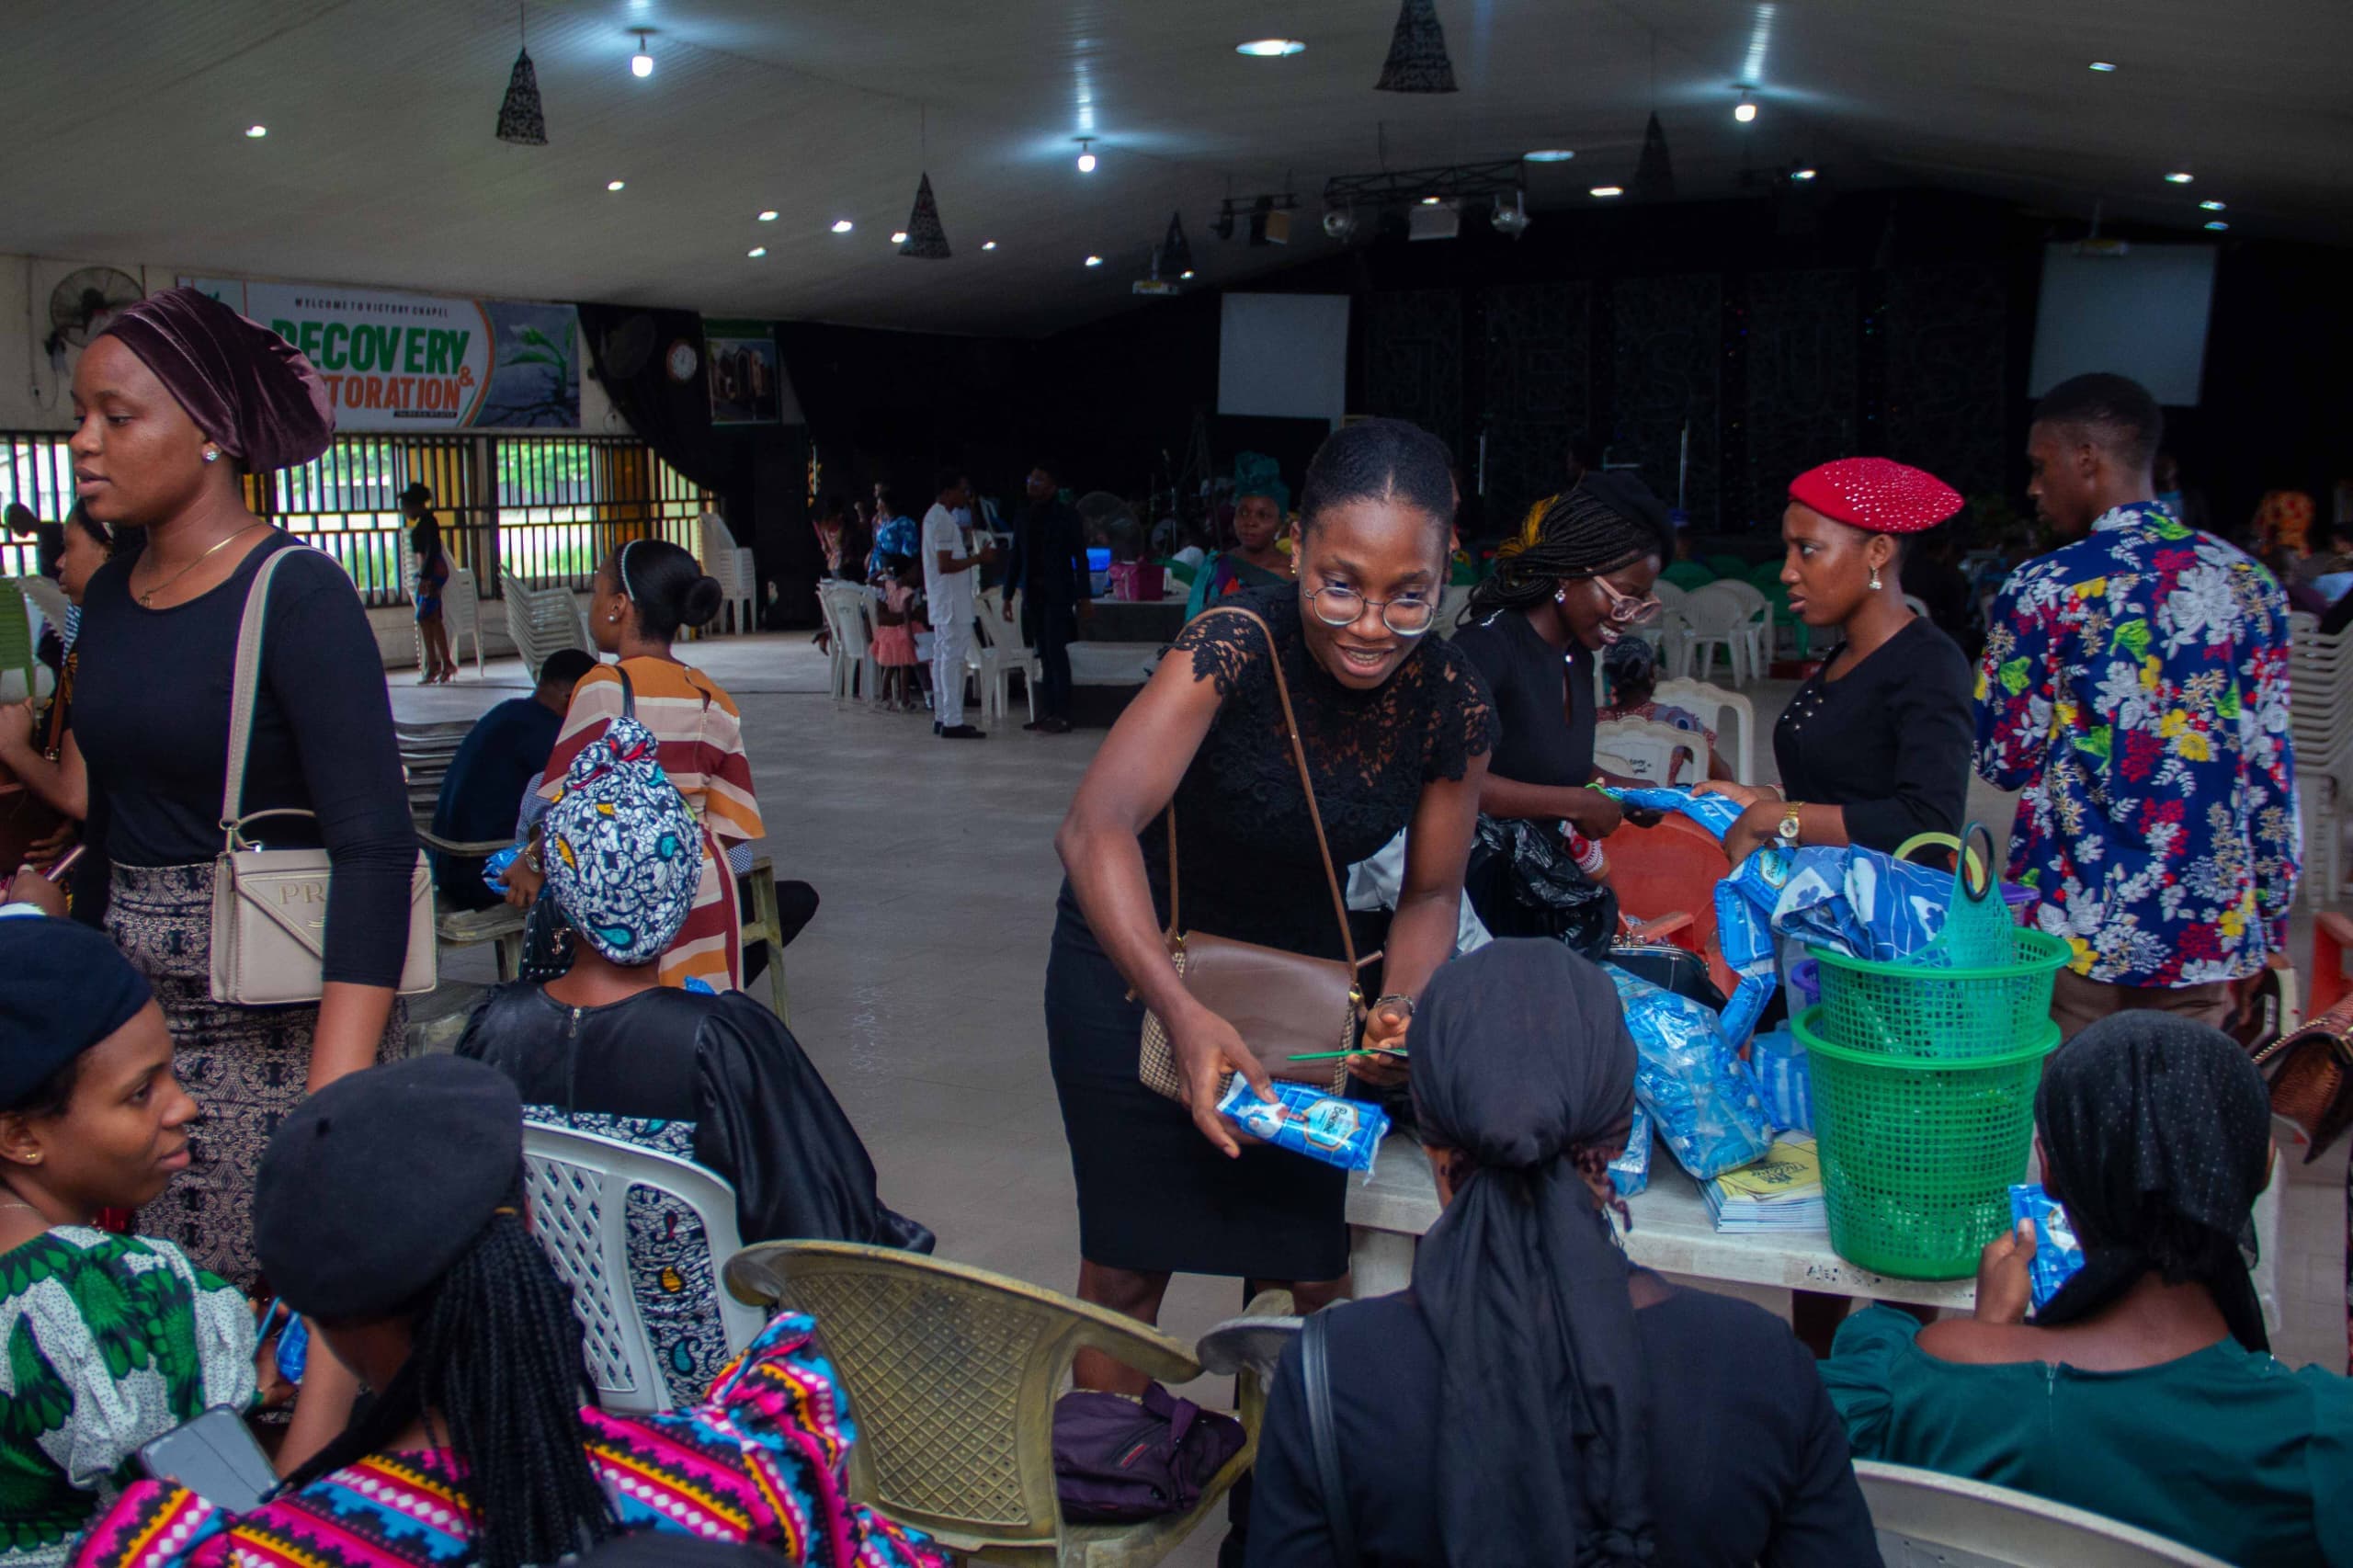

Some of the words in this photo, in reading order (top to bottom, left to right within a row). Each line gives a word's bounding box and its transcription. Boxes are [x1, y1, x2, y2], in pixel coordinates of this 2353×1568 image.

[295, 298, 347, 311] WELCOME
[351, 301, 364, 312] TO
[368, 302, 409, 315] VICTORY
[413, 306, 449, 318] CHAPEL
[459, 365, 475, 387] &
[322, 374, 460, 410] TORATION
[278, 881, 325, 904] PR
